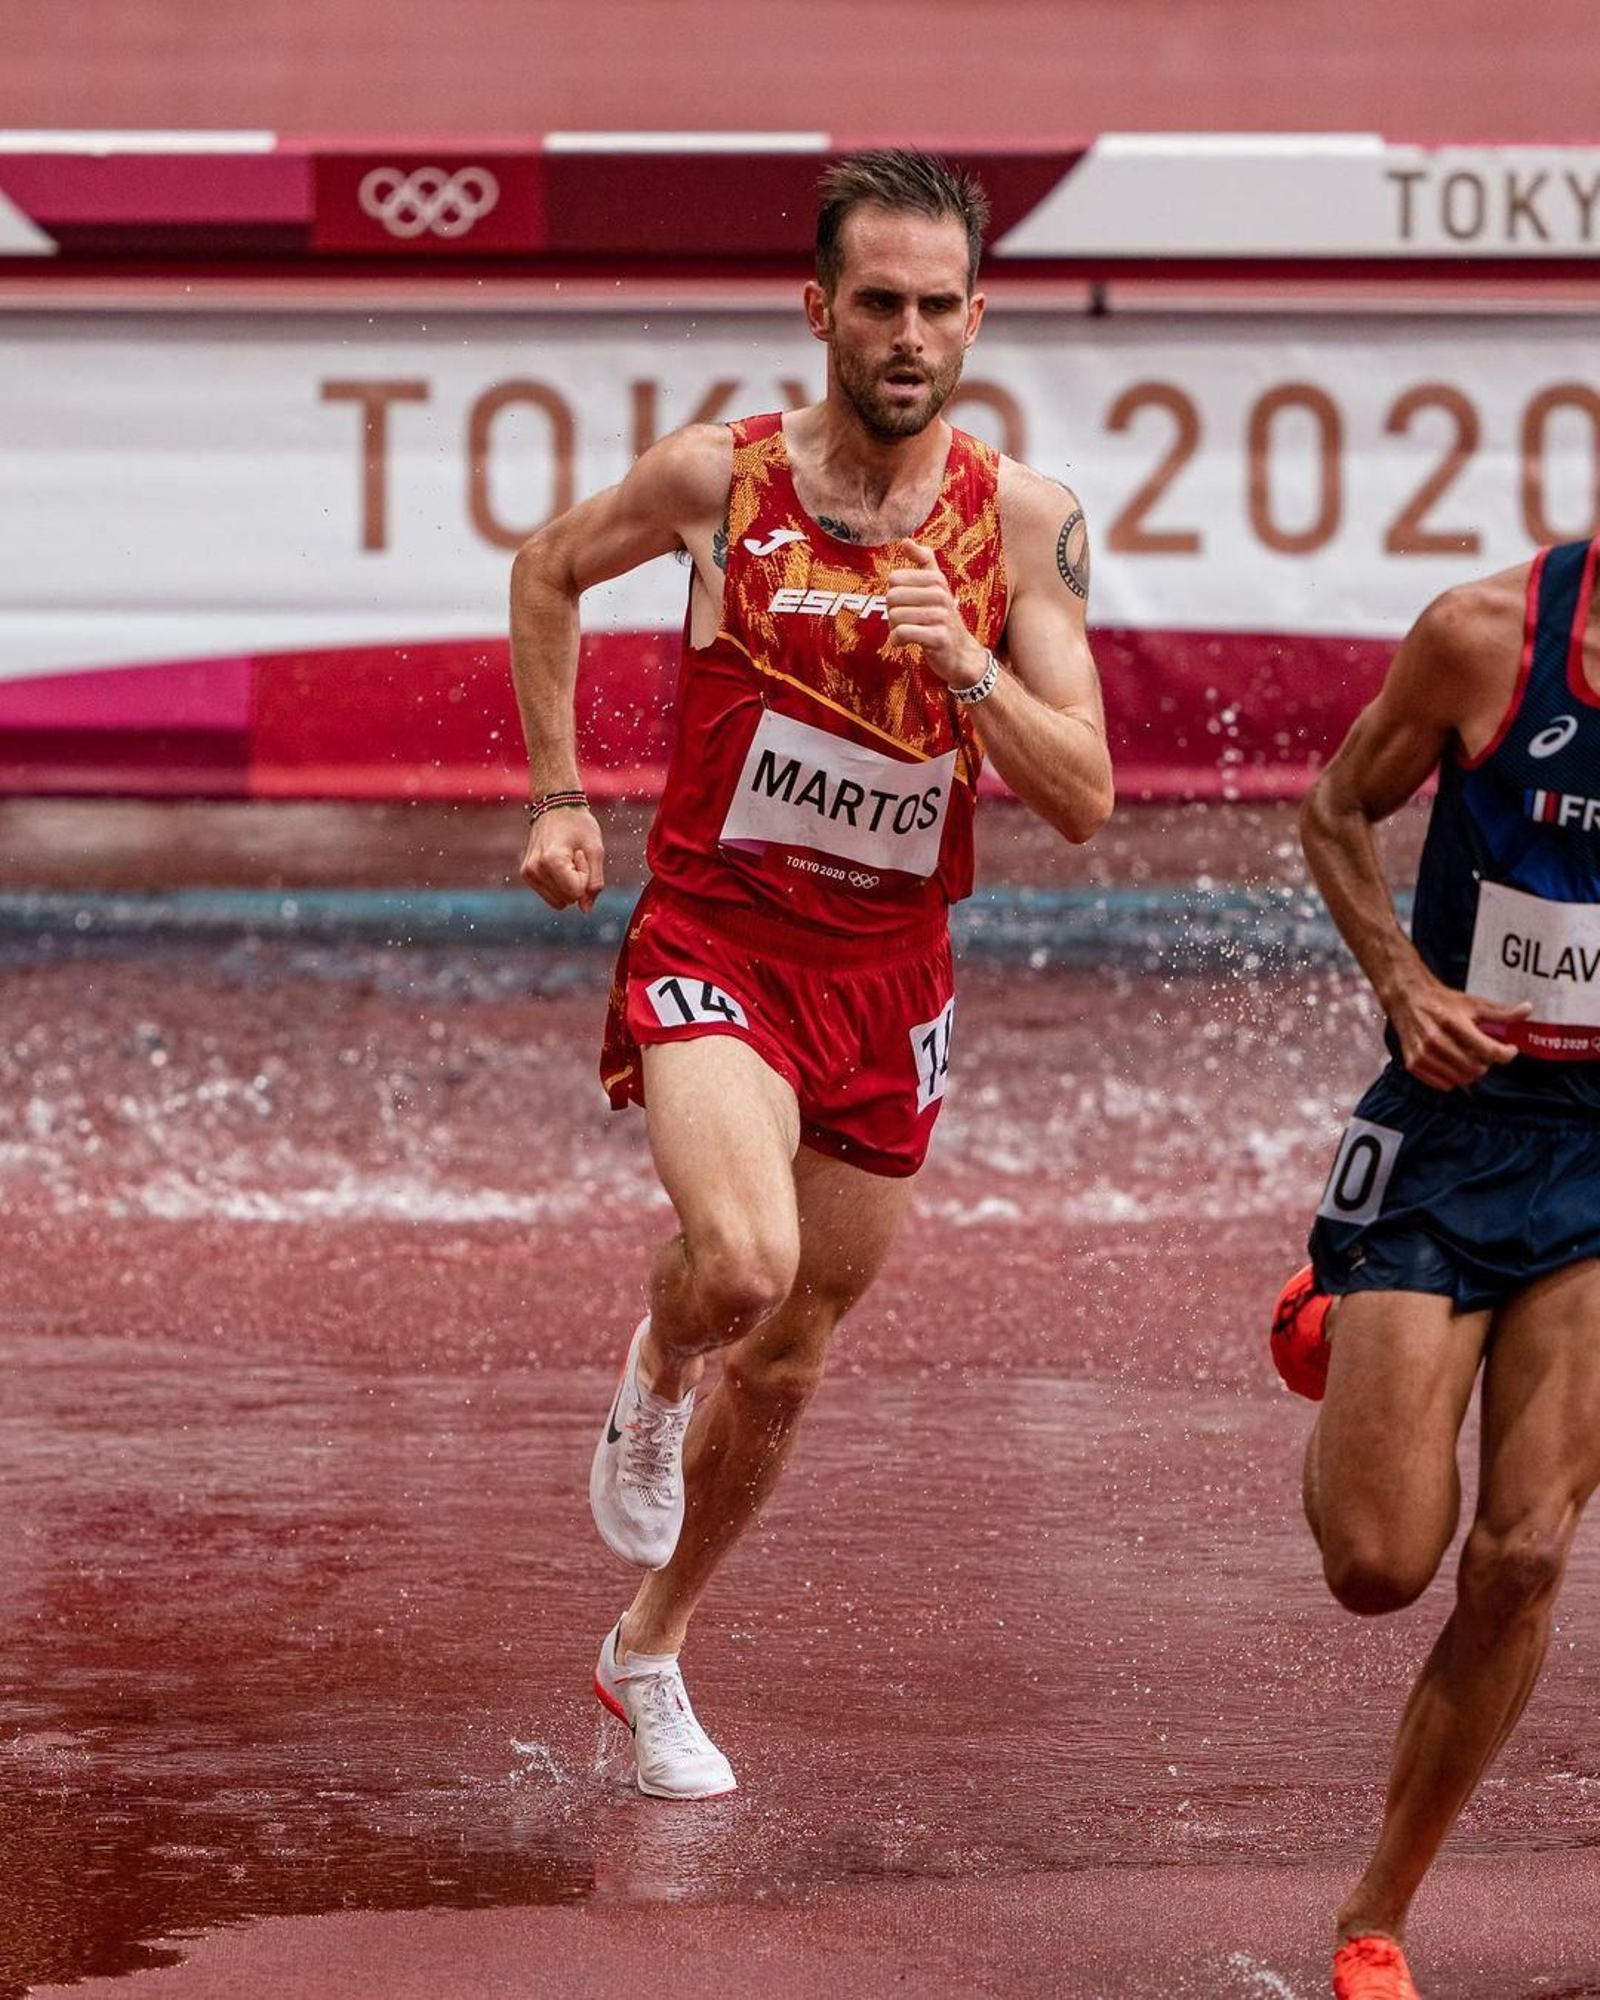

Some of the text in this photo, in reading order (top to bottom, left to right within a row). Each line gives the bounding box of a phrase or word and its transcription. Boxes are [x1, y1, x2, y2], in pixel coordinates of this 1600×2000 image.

[1386, 170, 1600, 241] TOKY
[1105, 380, 1600, 556] 2020
[750, 748, 942, 835] MARTOS
[785, 855, 846, 880] TOKYO 2020
[1501, 933, 1600, 982] GILAV
[658, 978, 738, 1023] 14
